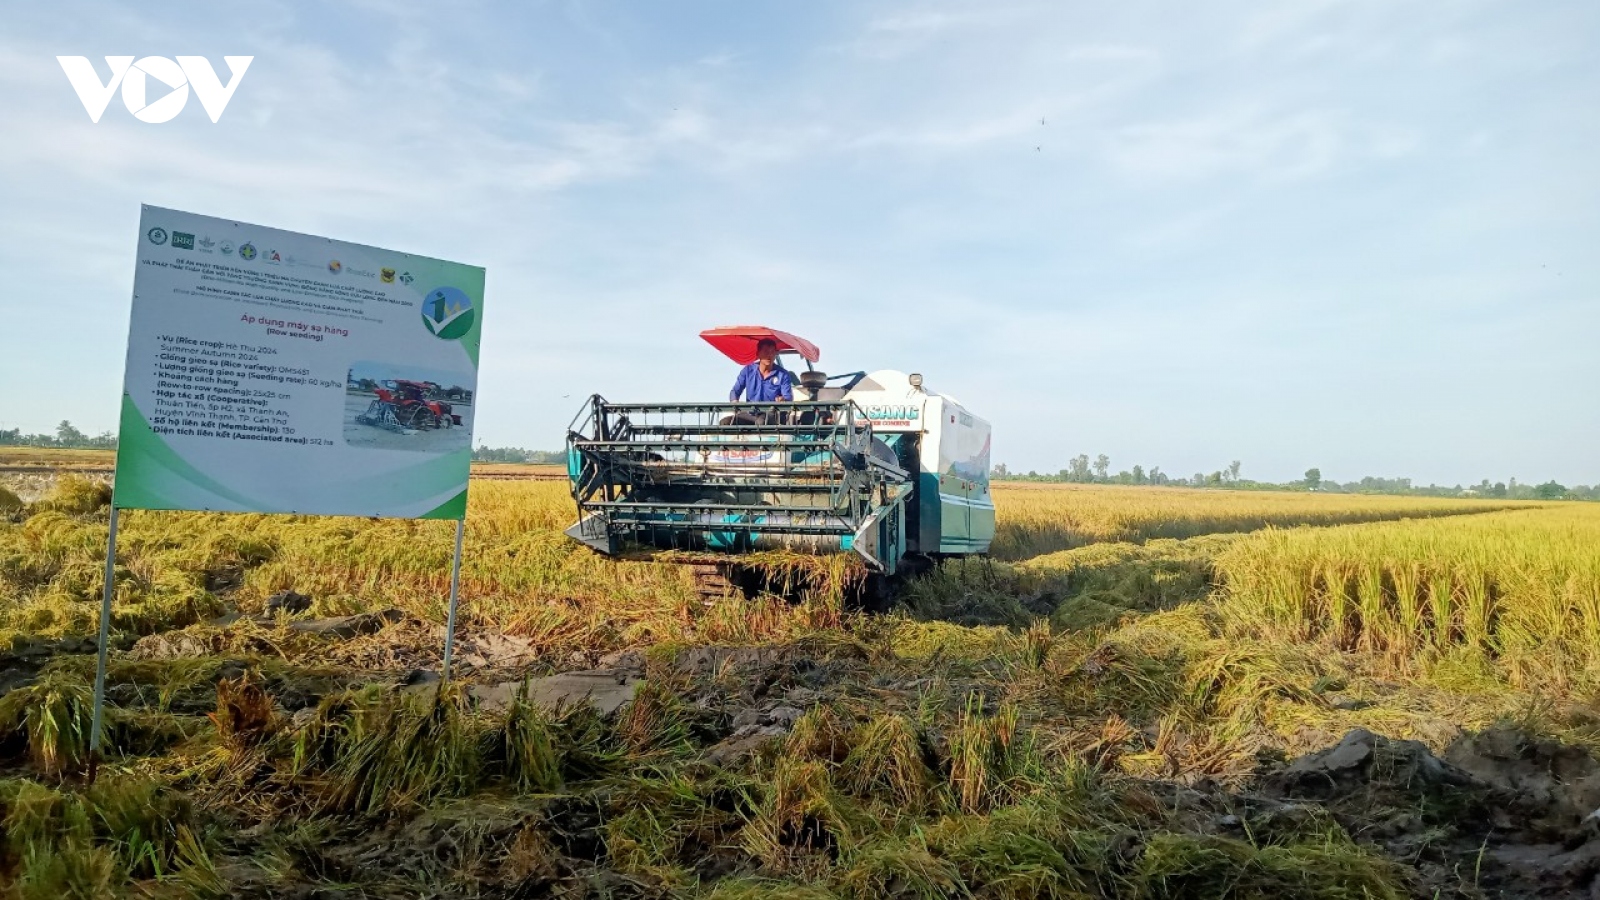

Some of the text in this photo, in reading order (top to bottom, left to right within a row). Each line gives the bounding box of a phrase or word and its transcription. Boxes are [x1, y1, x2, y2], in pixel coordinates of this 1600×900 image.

[240, 312, 349, 337] Áp dụng máy sạ hàng
[267, 328, 324, 341] (Row seeding)
[161, 343, 259, 361] Summer Autumn 2024
[162, 335, 277, 354] Vụ (Rice crop): Hè Thu 2024
[160, 353, 186, 364] Giống
[188, 356, 207, 365] gieo
[221, 359, 242, 368] (Rice
[244, 363, 277, 373] variety):
[158, 371, 239, 387] Khoảng cách hàng
[159, 362, 187, 372] Lượng
[189, 366, 214, 376] giống
[216, 369, 235, 377] gieo
[248, 371, 284, 383] (Seeding
[285, 377, 306, 385] rate):
[157, 389, 176, 399] Hợp
[178, 391, 192, 399] tác
[207, 394, 268, 406] (Cooperative):
[213, 387, 251, 397] spacing):
[253, 389, 276, 398] 25x25
[154, 416, 165, 425] Số
[167, 418, 179, 426] hộ
[182, 419, 198, 427] liên
[200, 420, 216, 428] kết
[218, 422, 280, 434] (Membership):
[153, 426, 174, 435] Diện
[176, 428, 195, 436] tích
[196, 429, 214, 437] liên
[215, 430, 231, 438] kết
[232, 431, 283, 442] (Associated
[284, 437, 308, 446] area):
